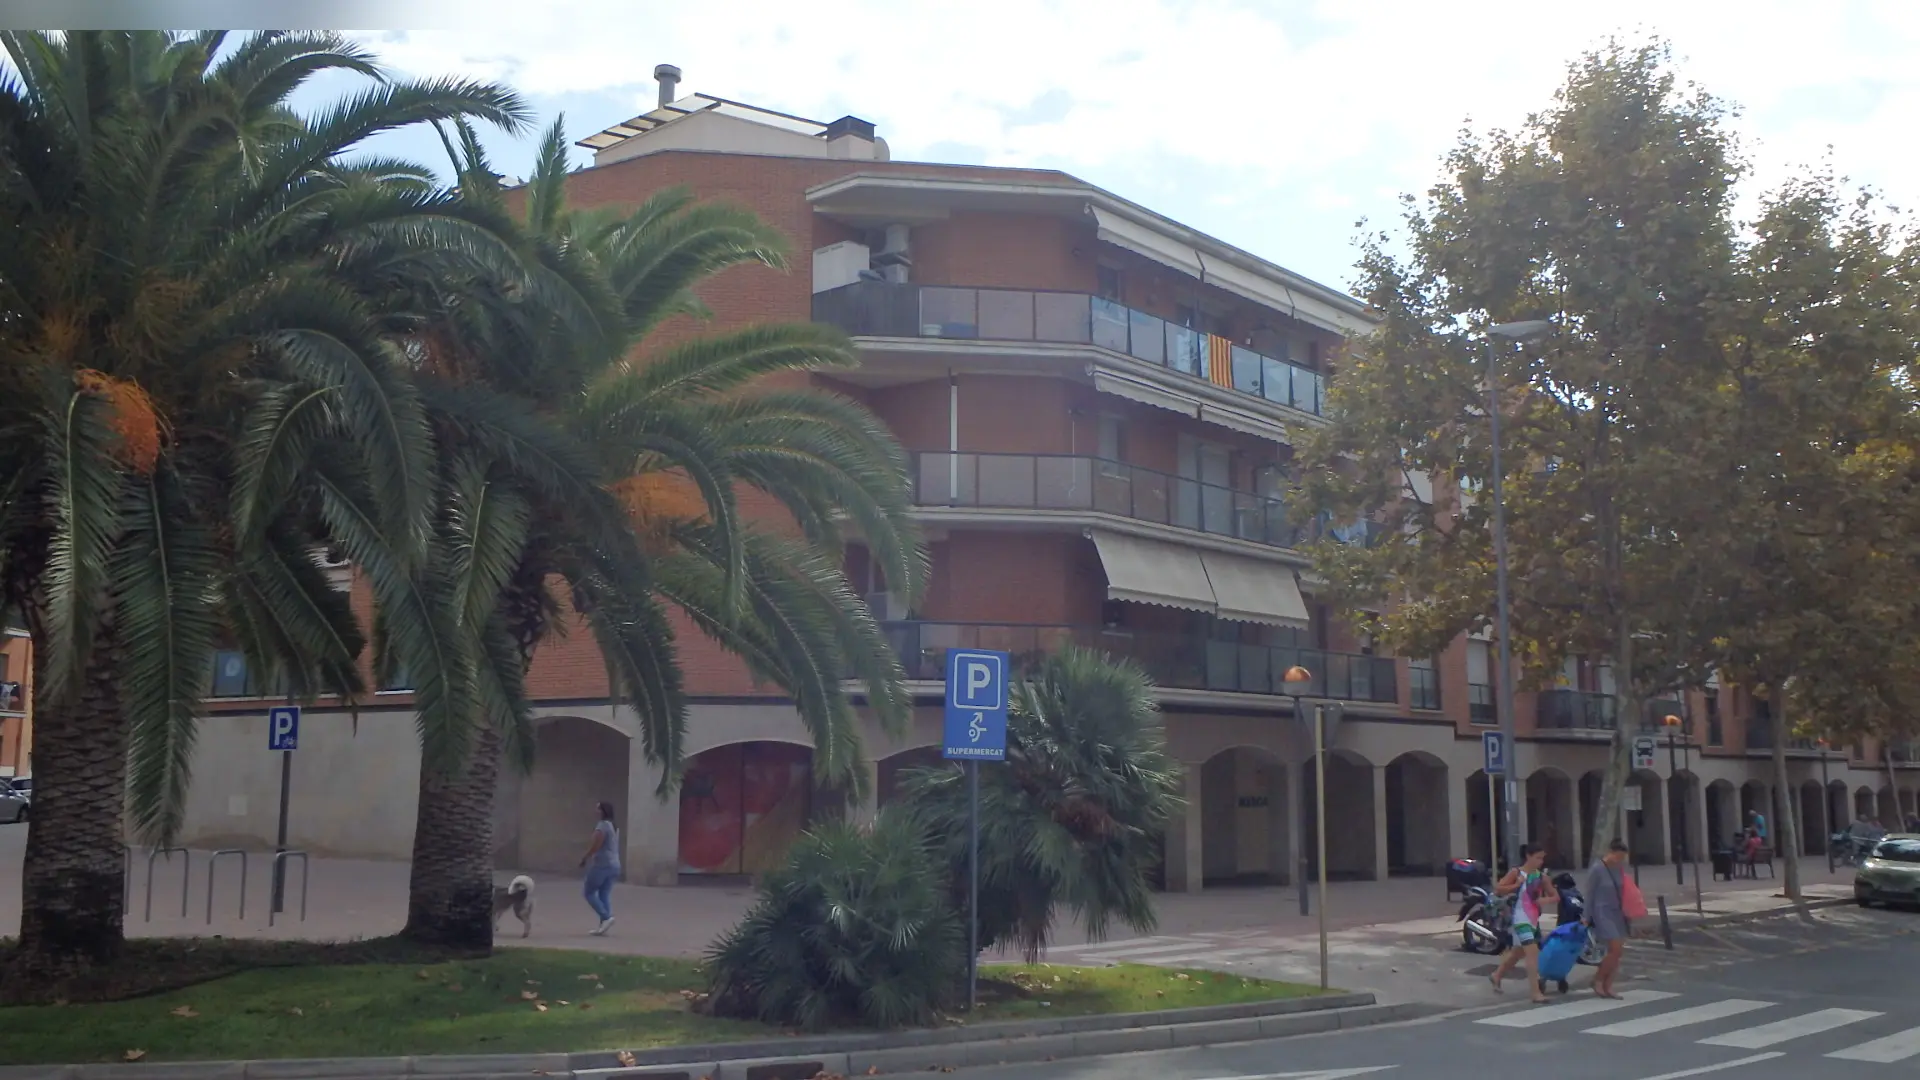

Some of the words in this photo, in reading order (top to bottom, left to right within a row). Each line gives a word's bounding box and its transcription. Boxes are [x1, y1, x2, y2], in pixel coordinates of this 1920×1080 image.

[967, 663, 991, 699] P
[274, 711, 293, 746] P
[947, 747, 1004, 756] SUPERMERCAT
[1487, 736, 1500, 769] P
